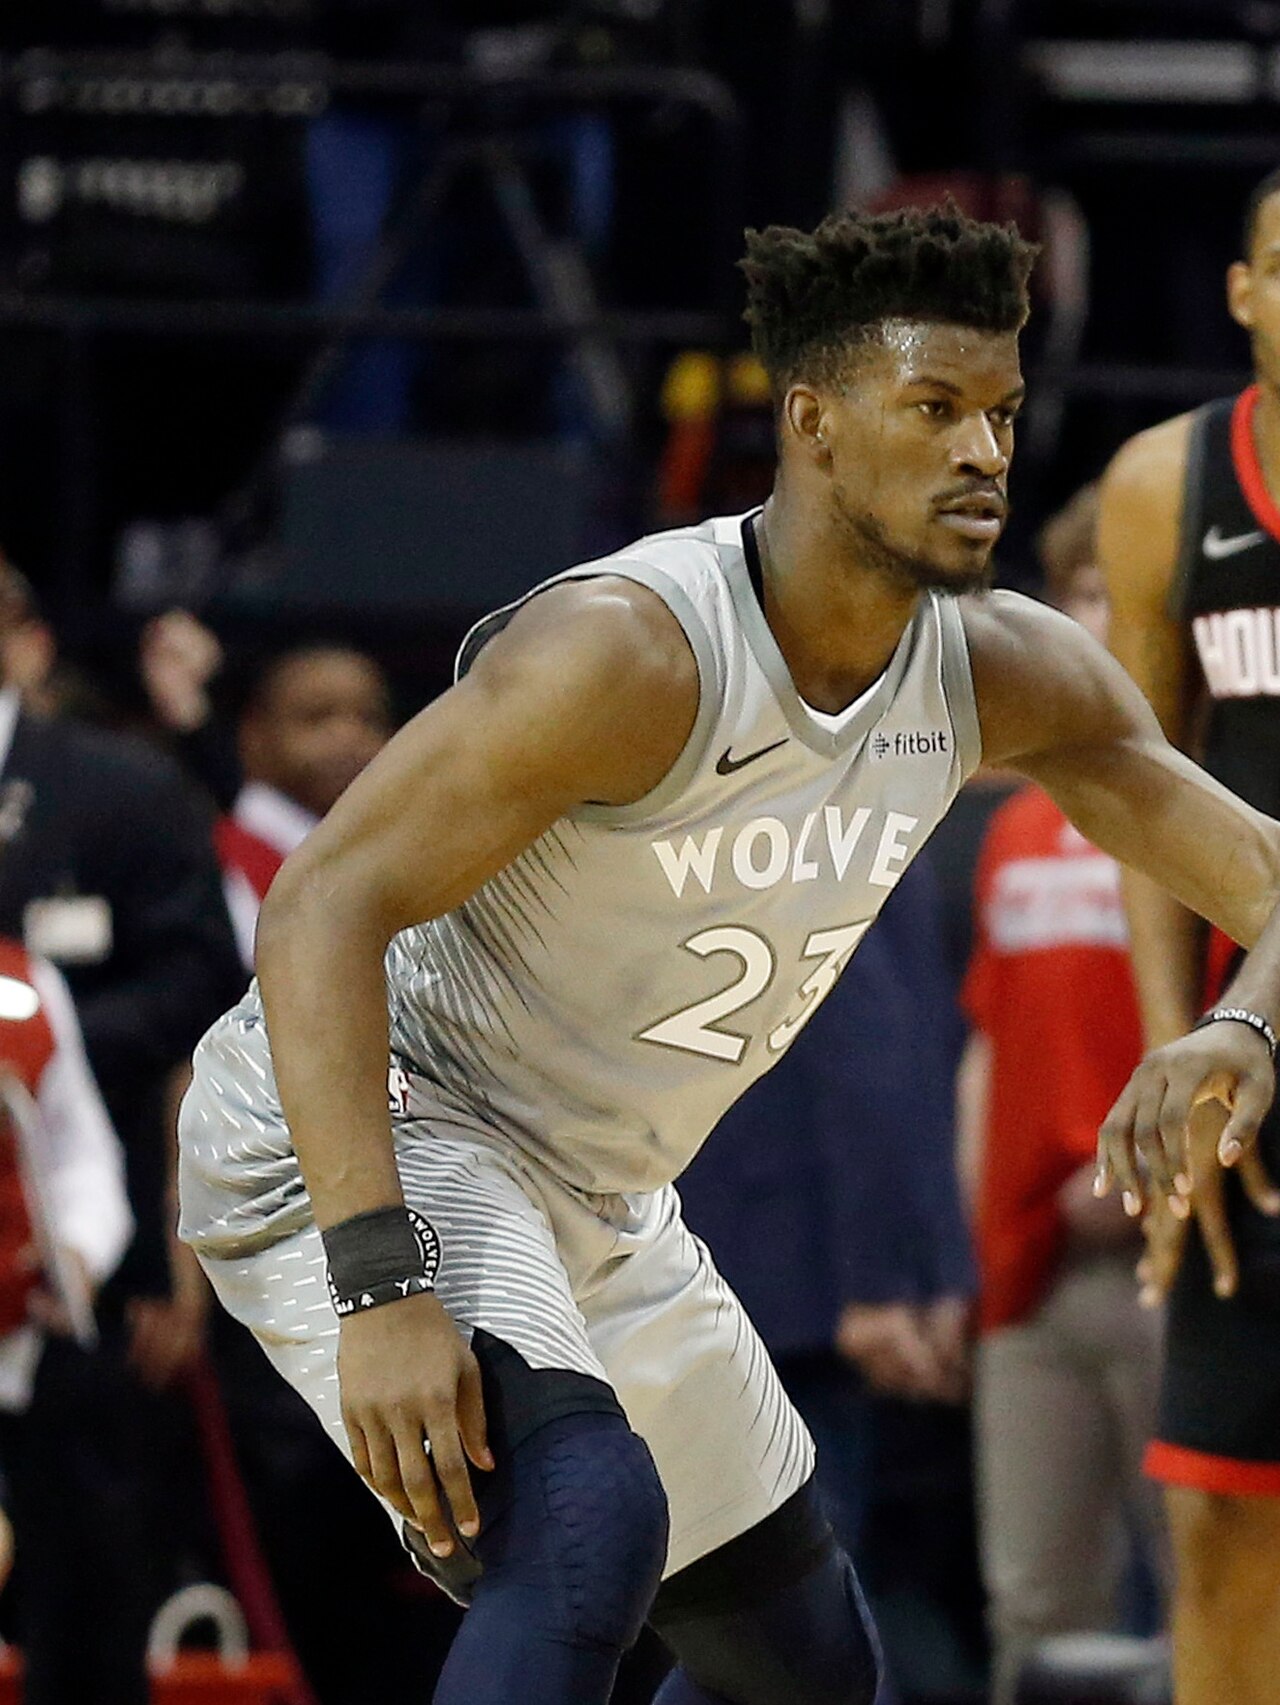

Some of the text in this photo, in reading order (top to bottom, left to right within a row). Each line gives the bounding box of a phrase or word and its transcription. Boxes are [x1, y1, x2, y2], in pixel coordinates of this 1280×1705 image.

[894, 731, 947, 755] fitbit
[651, 805, 918, 898] WOLVE
[635, 919, 872, 1065] 23
